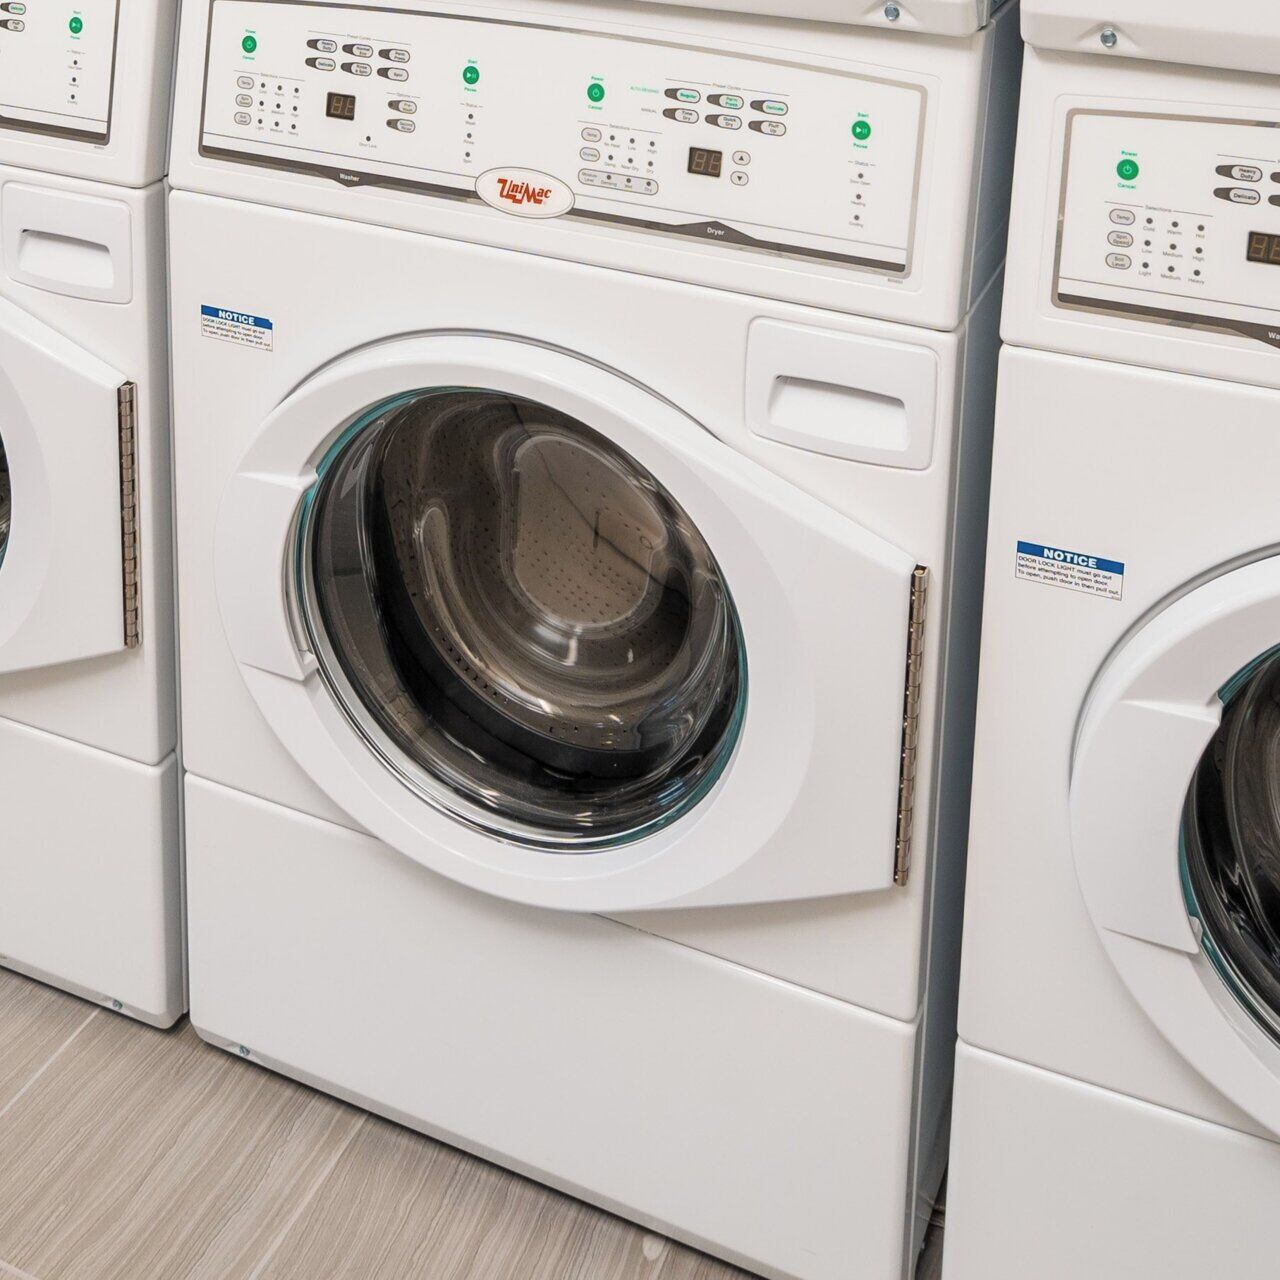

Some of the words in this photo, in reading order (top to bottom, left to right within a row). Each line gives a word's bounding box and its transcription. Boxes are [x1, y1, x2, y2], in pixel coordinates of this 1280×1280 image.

[497, 178, 551, 205] UniMac
[1233, 193, 1257, 201] Delicate
[707, 227, 725, 236] Dryer
[219, 311, 255, 325] NOTICE
[1043, 549, 1097, 568] NOTICE
[1038, 559, 1055, 568] LOCK
[1057, 564, 1075, 572] LIGHT
[1038, 567, 1069, 578] attempting
